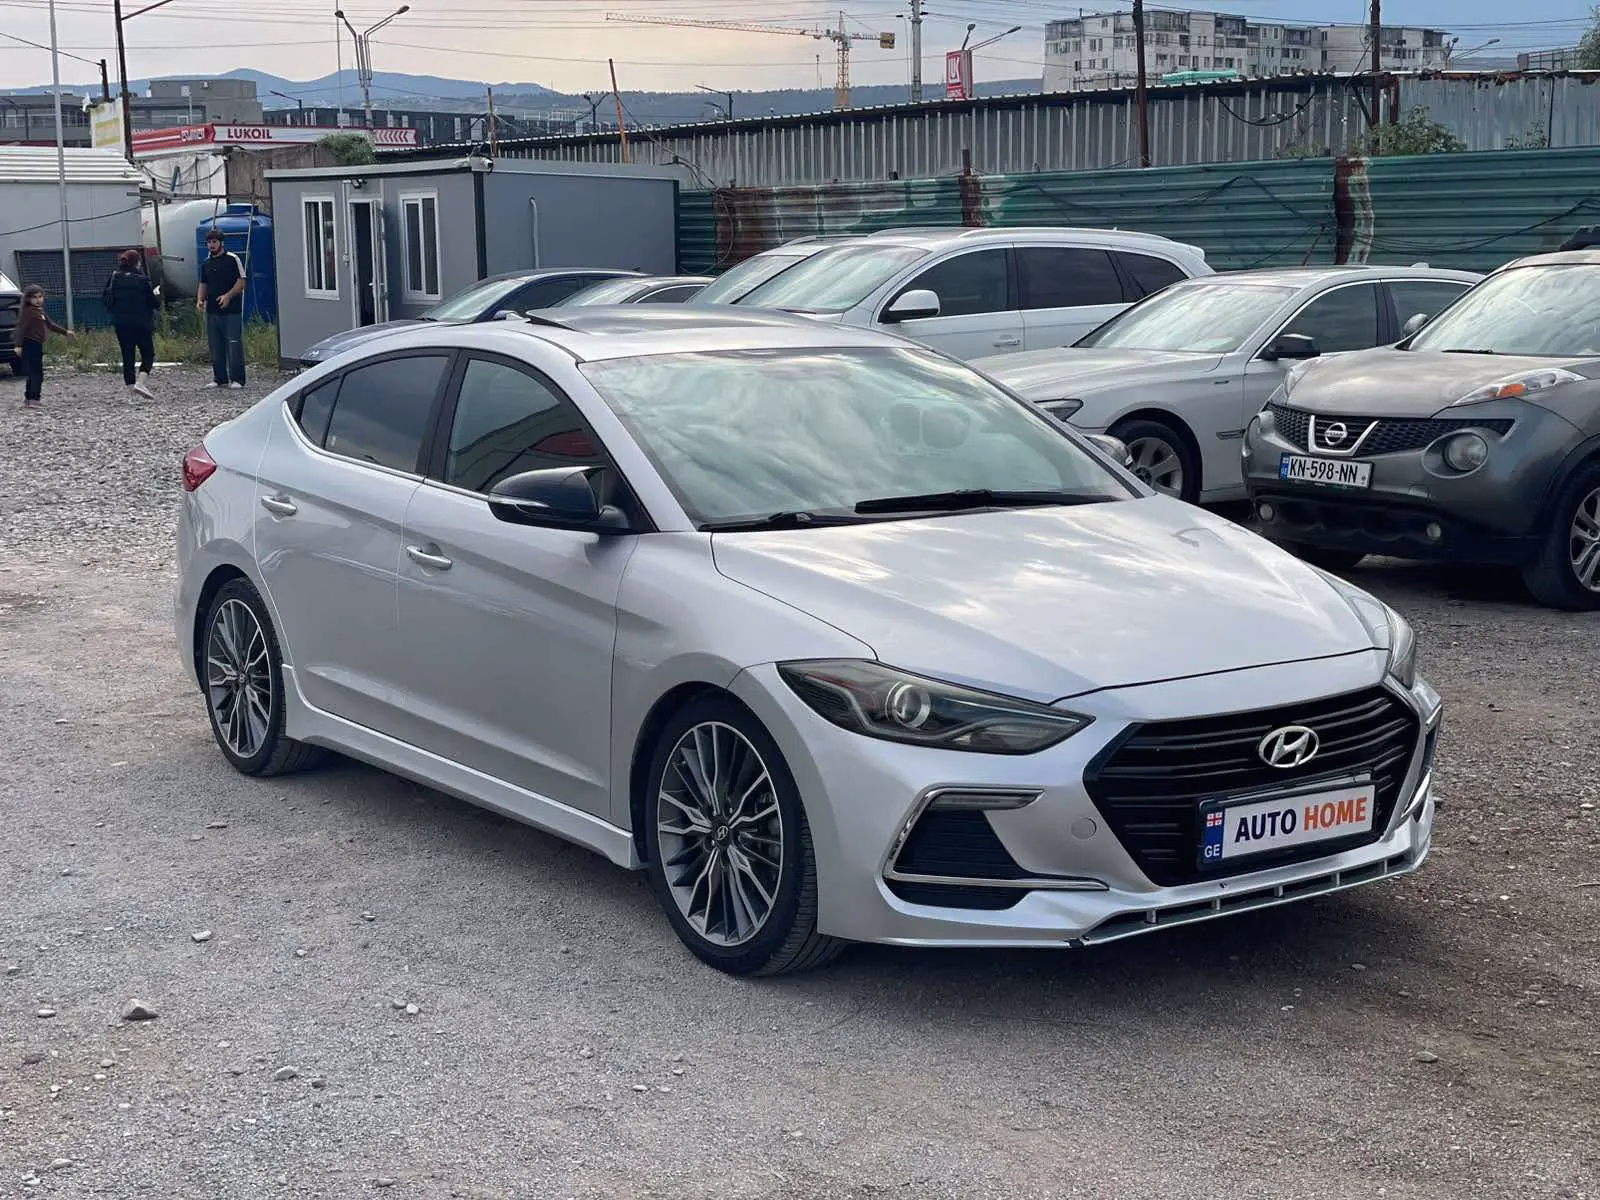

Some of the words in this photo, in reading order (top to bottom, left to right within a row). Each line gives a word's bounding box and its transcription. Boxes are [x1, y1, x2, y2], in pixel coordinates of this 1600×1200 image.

[227, 128, 273, 140] LUKOIL
[1289, 458, 1358, 483] KN-598-NN
[1234, 808, 1297, 843] AUTO
[1303, 797, 1368, 831] HOME
[1204, 843, 1220, 858] GE
